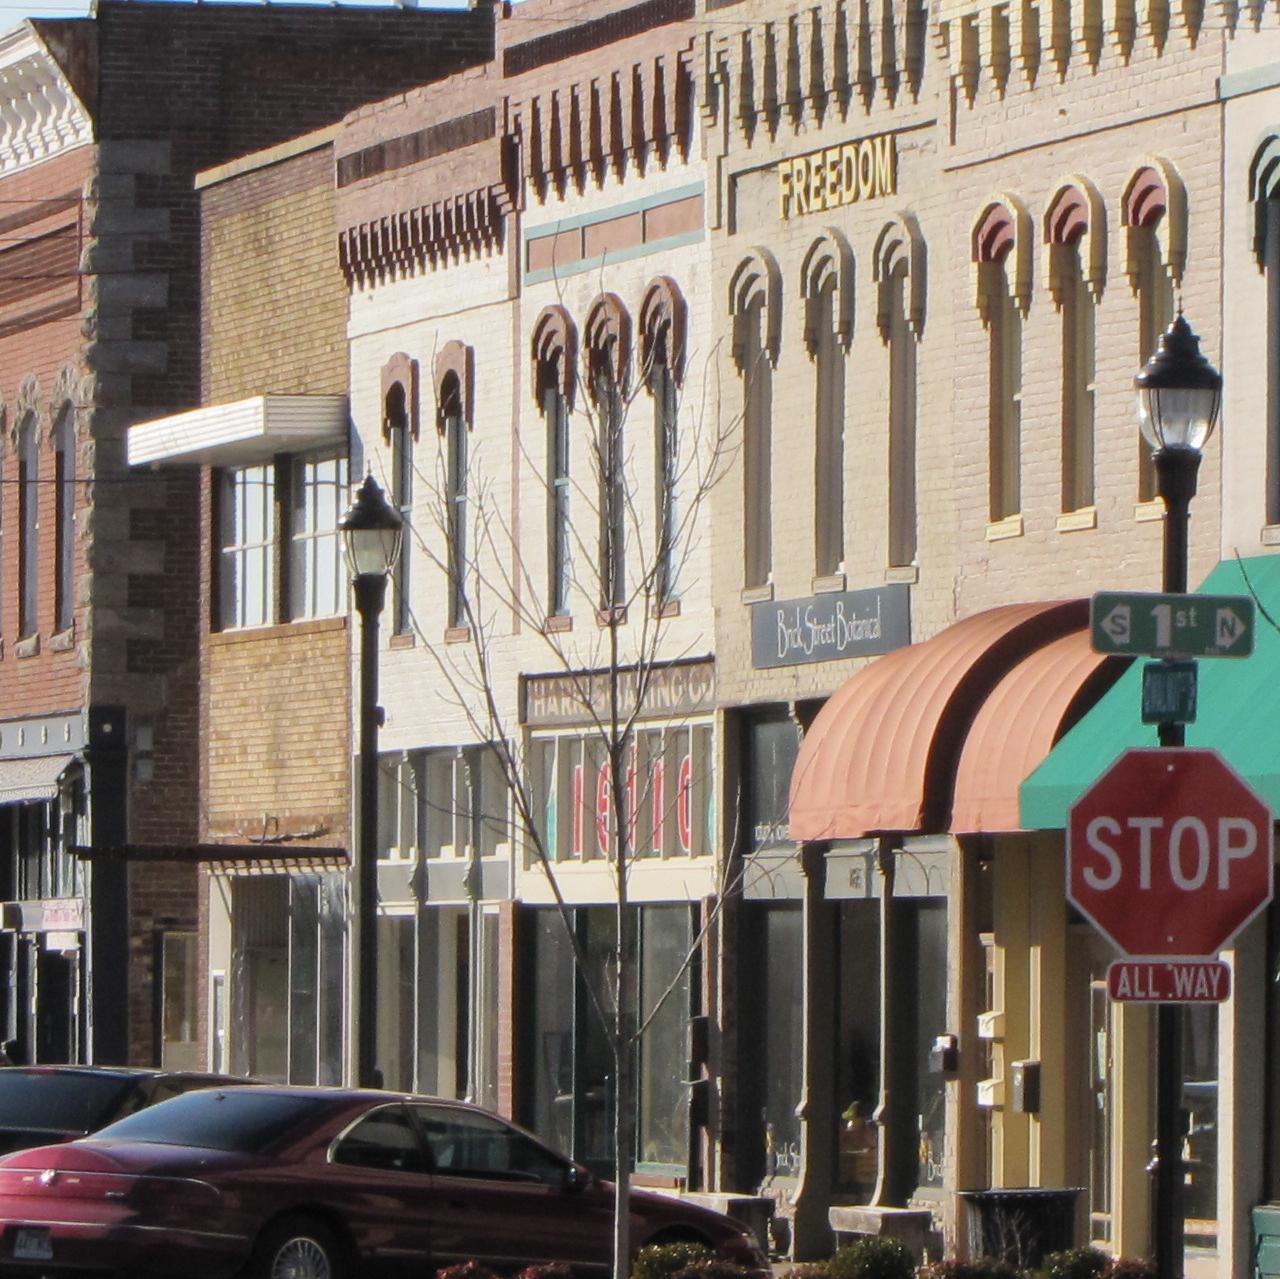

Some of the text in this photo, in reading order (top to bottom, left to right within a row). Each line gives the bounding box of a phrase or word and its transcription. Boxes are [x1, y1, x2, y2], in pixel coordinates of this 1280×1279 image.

[778, 133, 895, 219] FREEDOM
[776, 594, 882, 659] Brick Street Botanical
[1110, 614, 1127, 636] S
[1220, 616, 1236, 639] N
[1082, 815, 1259, 892] STOP
[1116, 965, 1222, 998] ALL WAY
